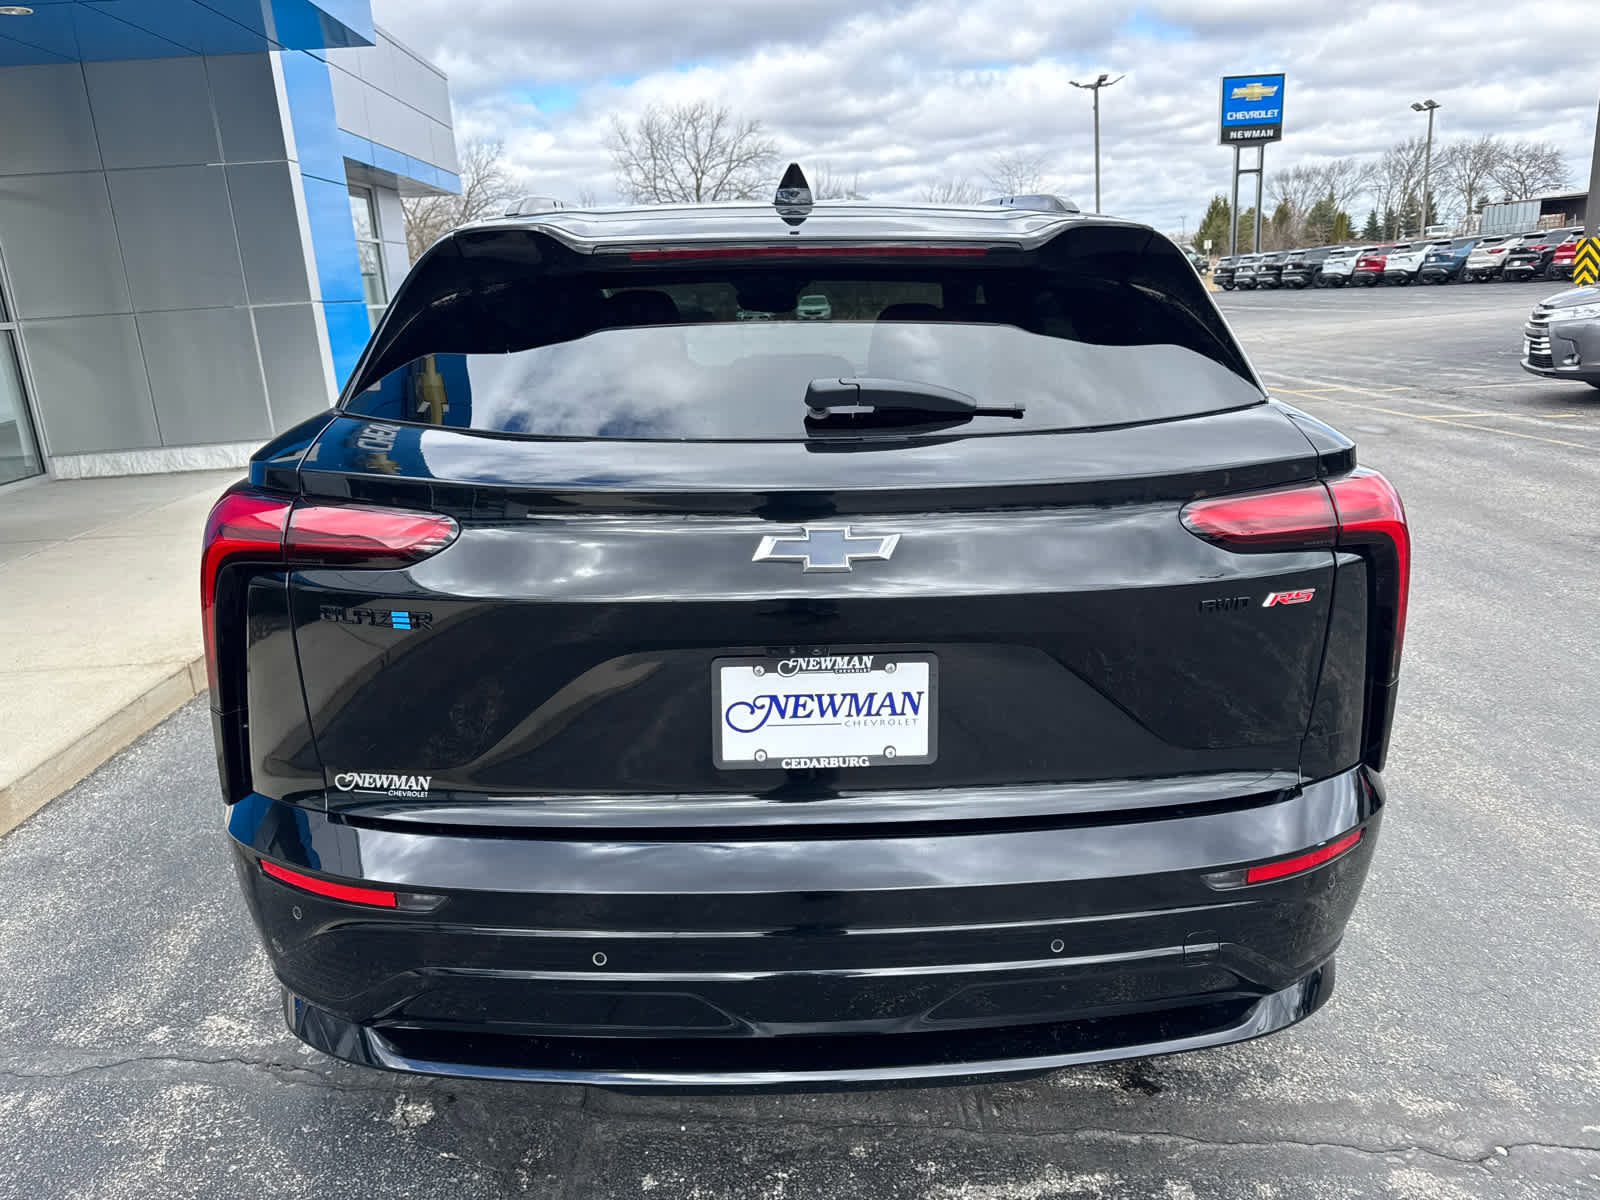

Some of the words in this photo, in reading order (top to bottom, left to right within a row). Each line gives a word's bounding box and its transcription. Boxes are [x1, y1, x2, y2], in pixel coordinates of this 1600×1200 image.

[1227, 109, 1279, 120] CHEVROLET
[1230, 129, 1274, 139] NEWMAN
[1264, 588, 1316, 607] RS
[778, 655, 874, 677] NEWMAN
[725, 691, 924, 733] NEWMAN
[844, 717, 919, 728] CHEVROLET
[781, 756, 870, 770] CEDARBURG
[334, 773, 432, 791] NEWMAN
[388, 789, 429, 798] CHEVROLET
